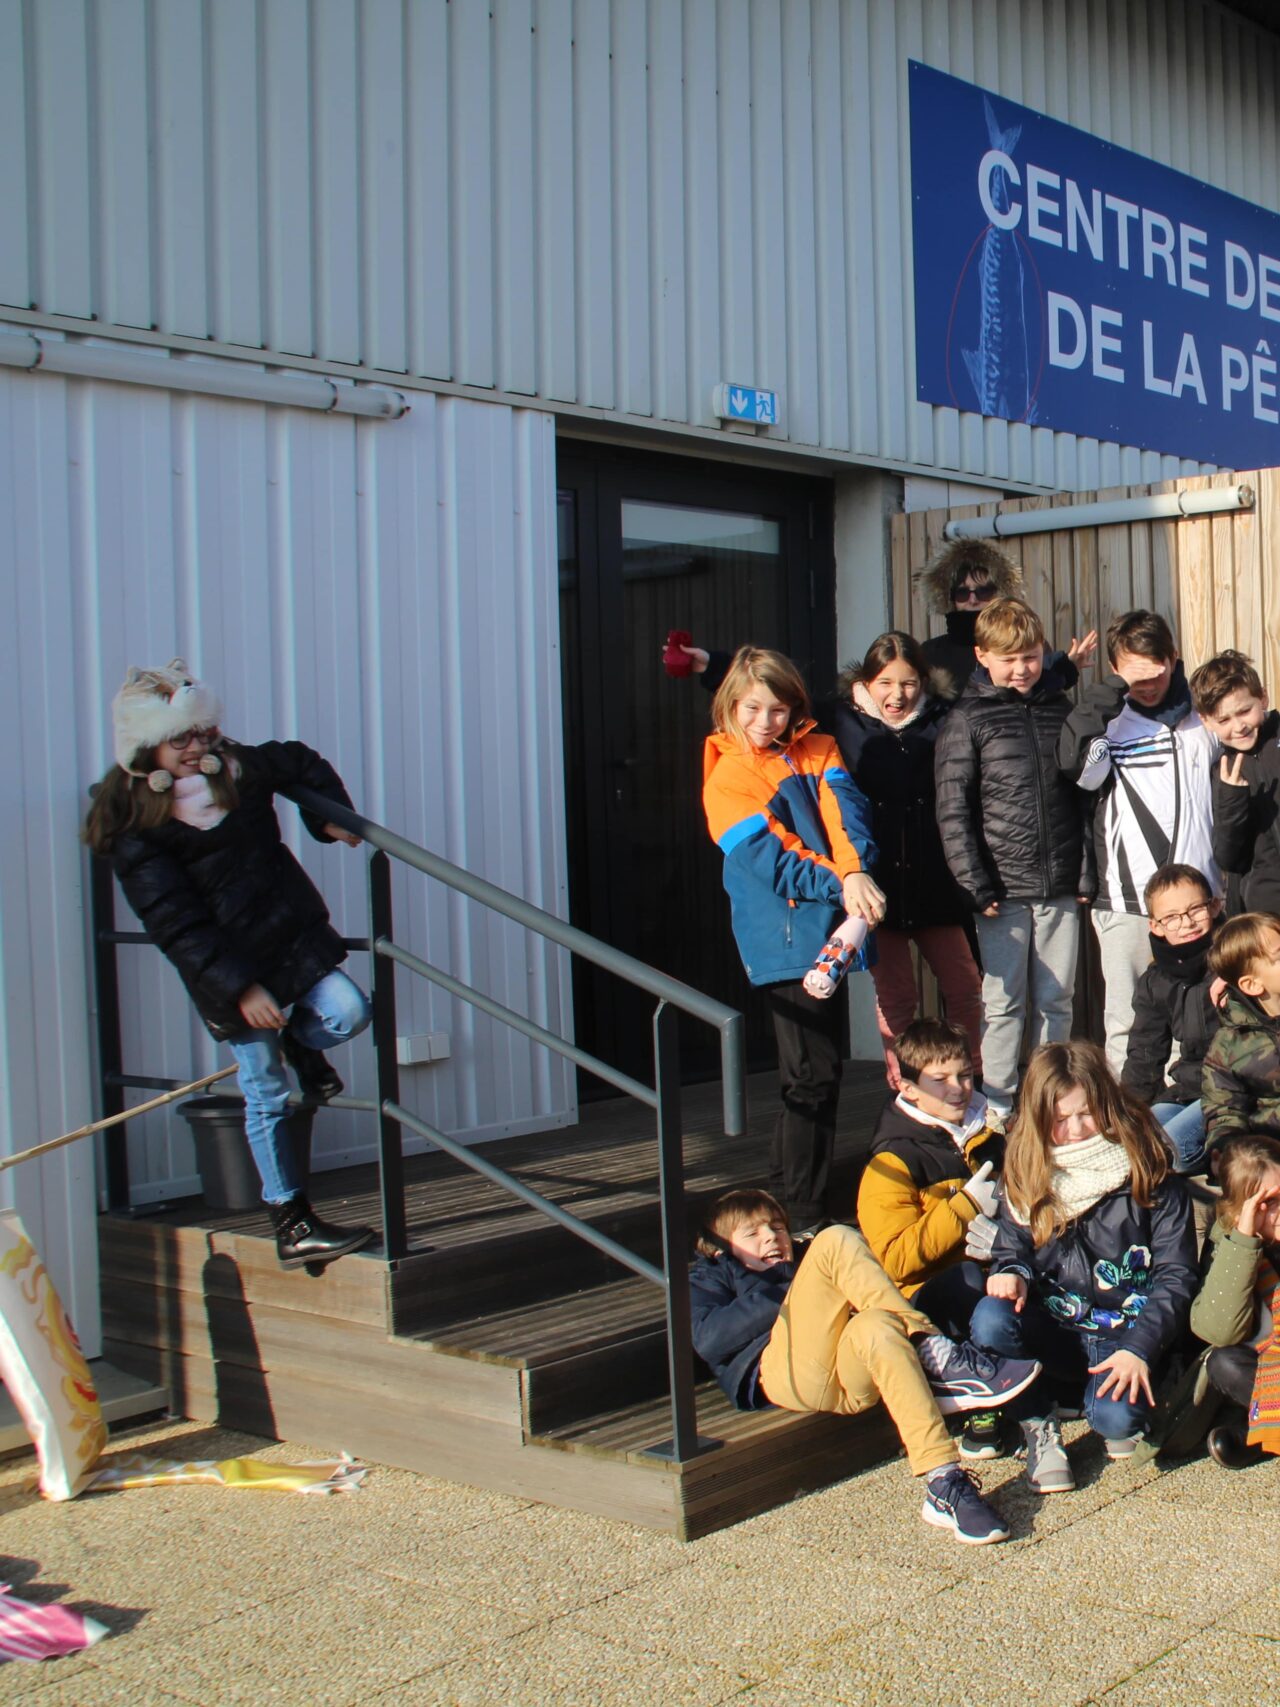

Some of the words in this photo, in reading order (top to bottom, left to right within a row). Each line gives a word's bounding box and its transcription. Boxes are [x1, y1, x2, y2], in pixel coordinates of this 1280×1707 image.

[978, 149, 1210, 298] CENTRE
[1048, 290, 1125, 384] DE
[1142, 320, 1208, 405] LA
